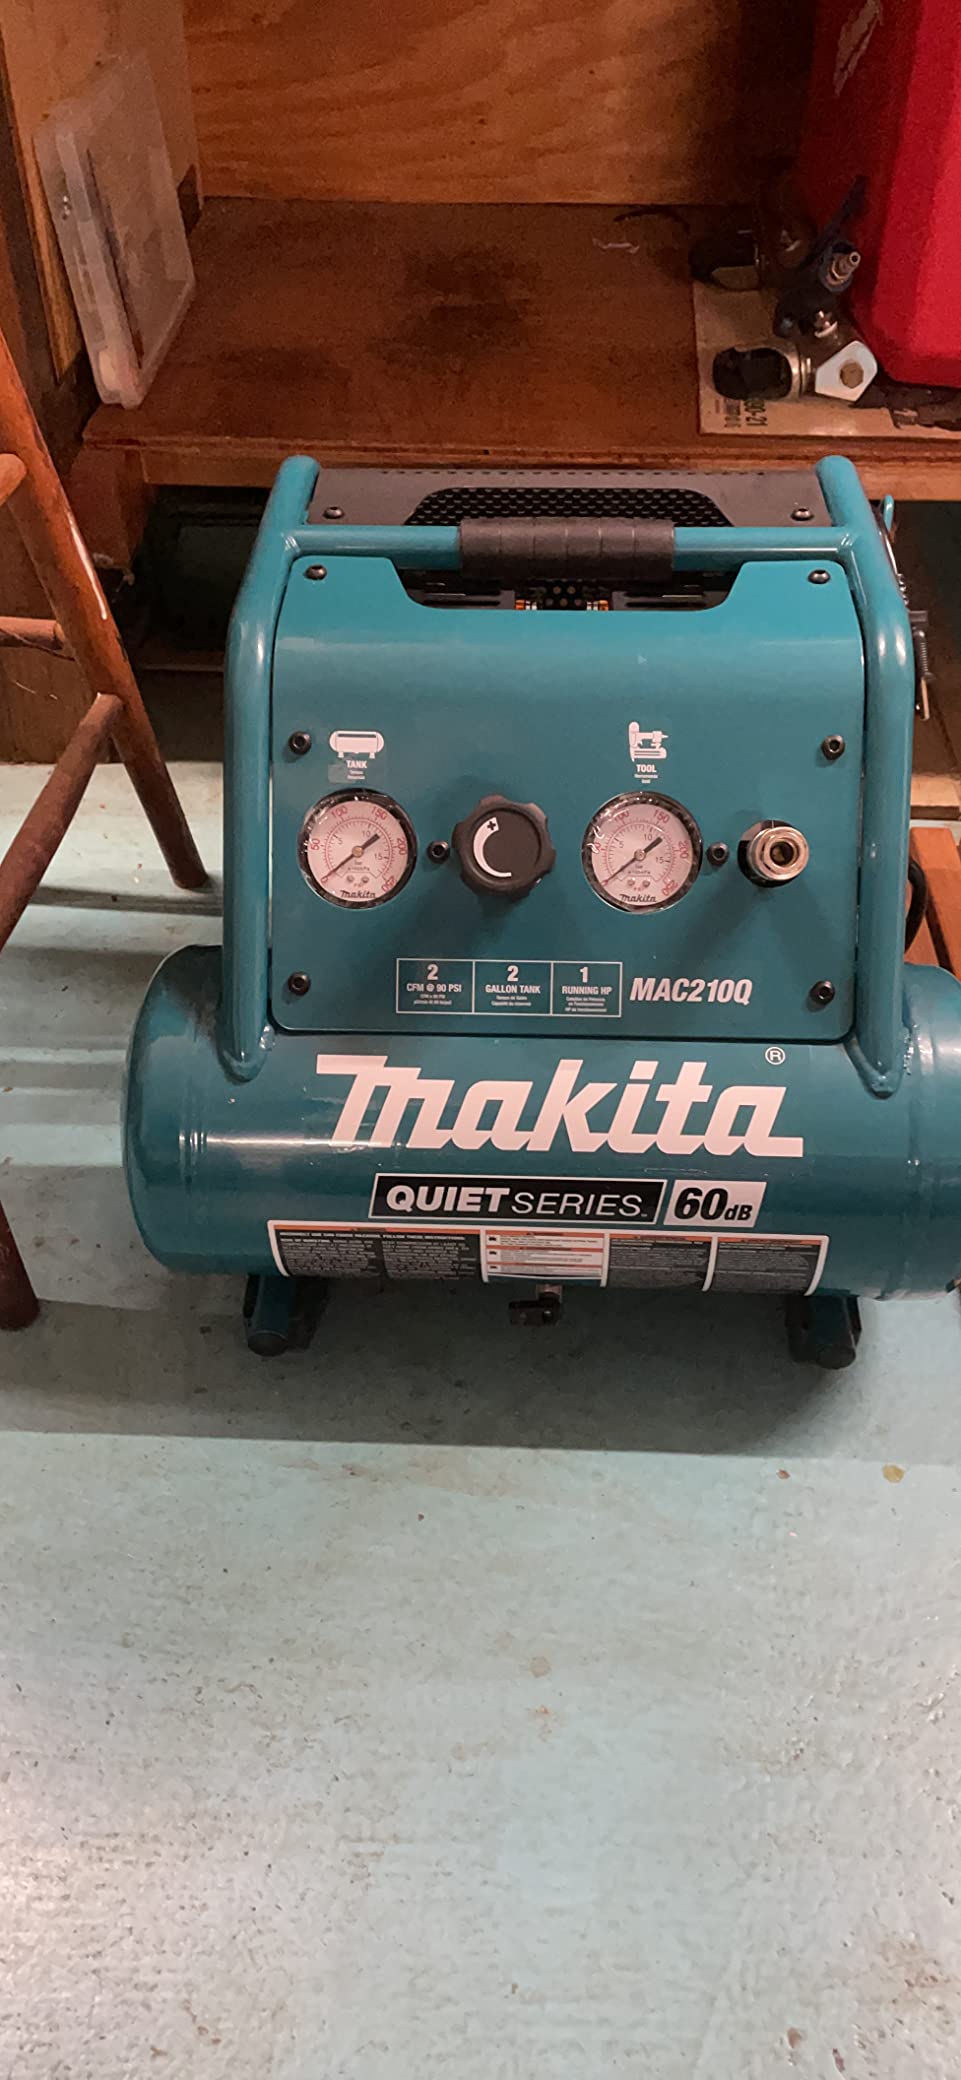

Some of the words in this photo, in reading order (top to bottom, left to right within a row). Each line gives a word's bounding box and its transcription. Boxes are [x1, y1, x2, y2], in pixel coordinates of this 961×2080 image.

[345, 760, 368, 769] TANK
[636, 764, 657, 773] TOOL
[331, 805, 348, 819] 100
[371, 806, 388, 820] 150
[653, 809, 670, 824] 150
[310, 838, 320, 851] 50
[397, 838, 408, 856] 200
[619, 841, 624, 849] 5
[678, 841, 690, 859] 200
[374, 853, 383, 861] 15
[655, 856, 664, 864] 15
[427, 964, 439, 980] 2
[507, 965, 519, 982] 2
[579, 966, 589, 983] 1
[406, 983, 425, 992] CFM
[426, 983, 435, 992] @
[436, 984, 447, 993] 90
[448, 984, 462, 993] PSI
[485, 985, 518, 994] GALLON
[519, 985, 541, 994] TANK
[562, 985, 599, 995] RUNNING
[600, 986, 613, 995] HP
[629, 977, 753, 1006] MAC210Q
[387, 1185, 511, 1214] QUIET
